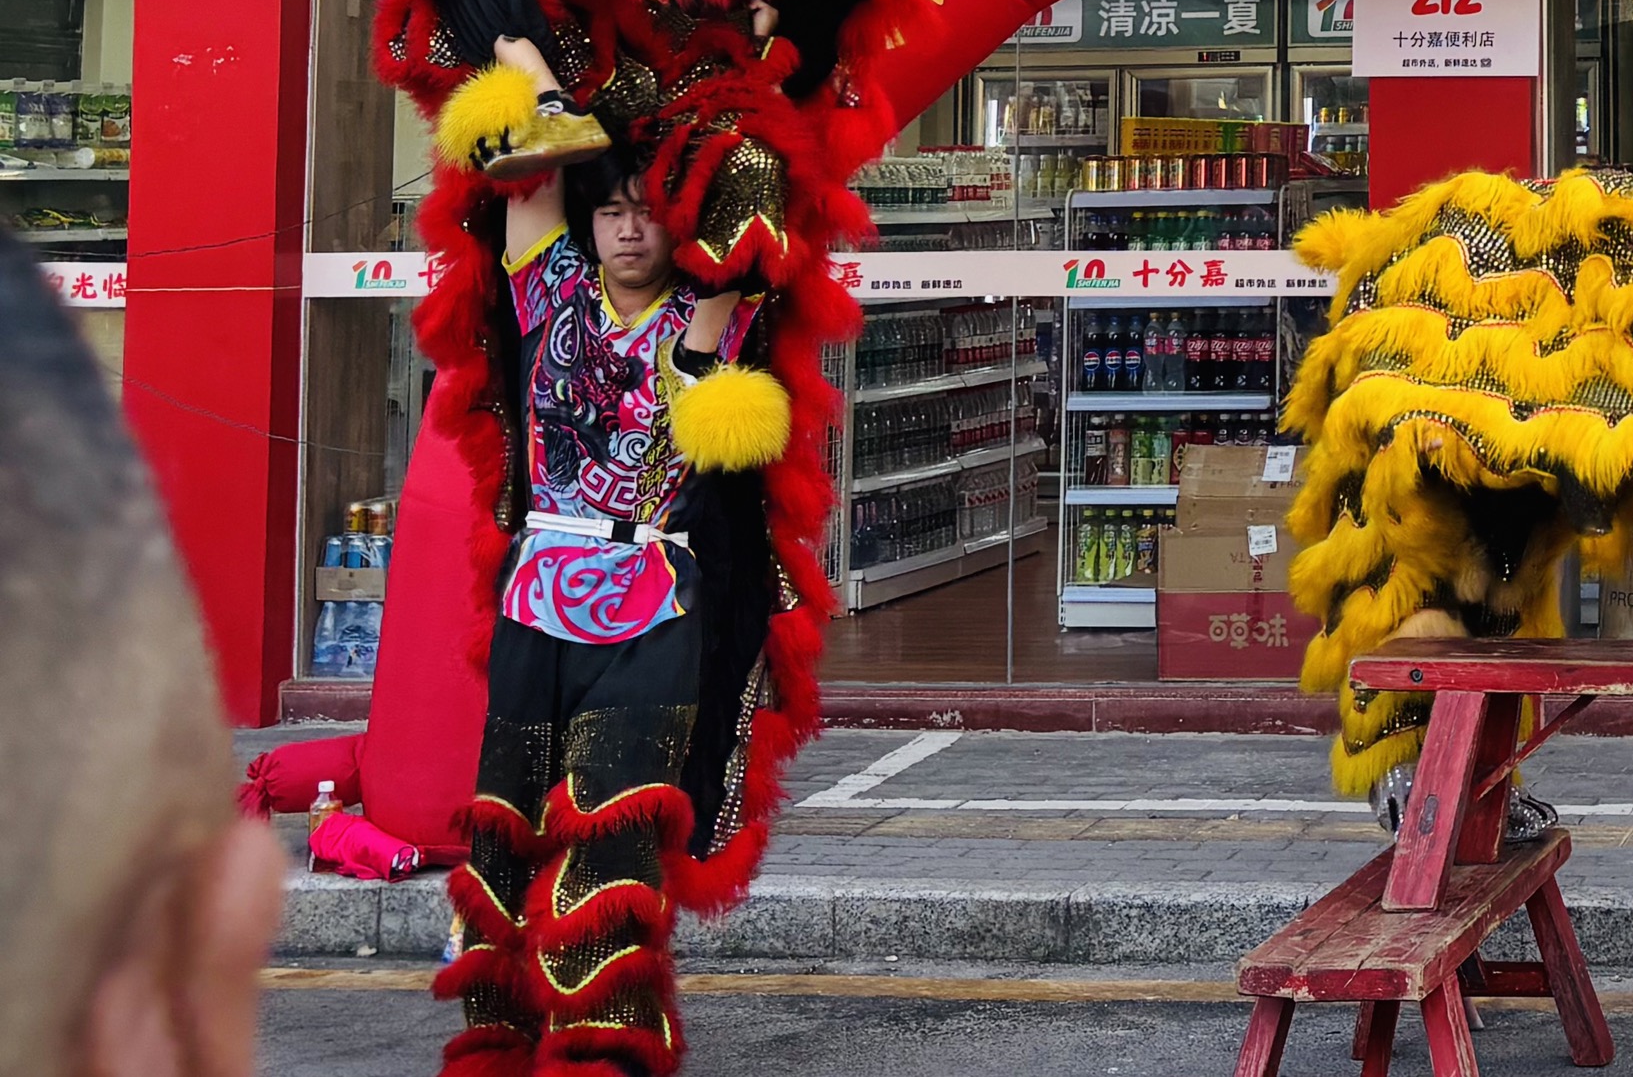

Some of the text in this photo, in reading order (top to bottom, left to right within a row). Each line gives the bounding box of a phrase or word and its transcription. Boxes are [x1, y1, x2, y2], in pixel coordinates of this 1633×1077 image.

[1393, 30, 1495, 48] 十分嘉便利店
[352, 260, 392, 289] 10
[1063, 259, 1105, 288] 10
[1132, 259, 1228, 288] 十分嘉
